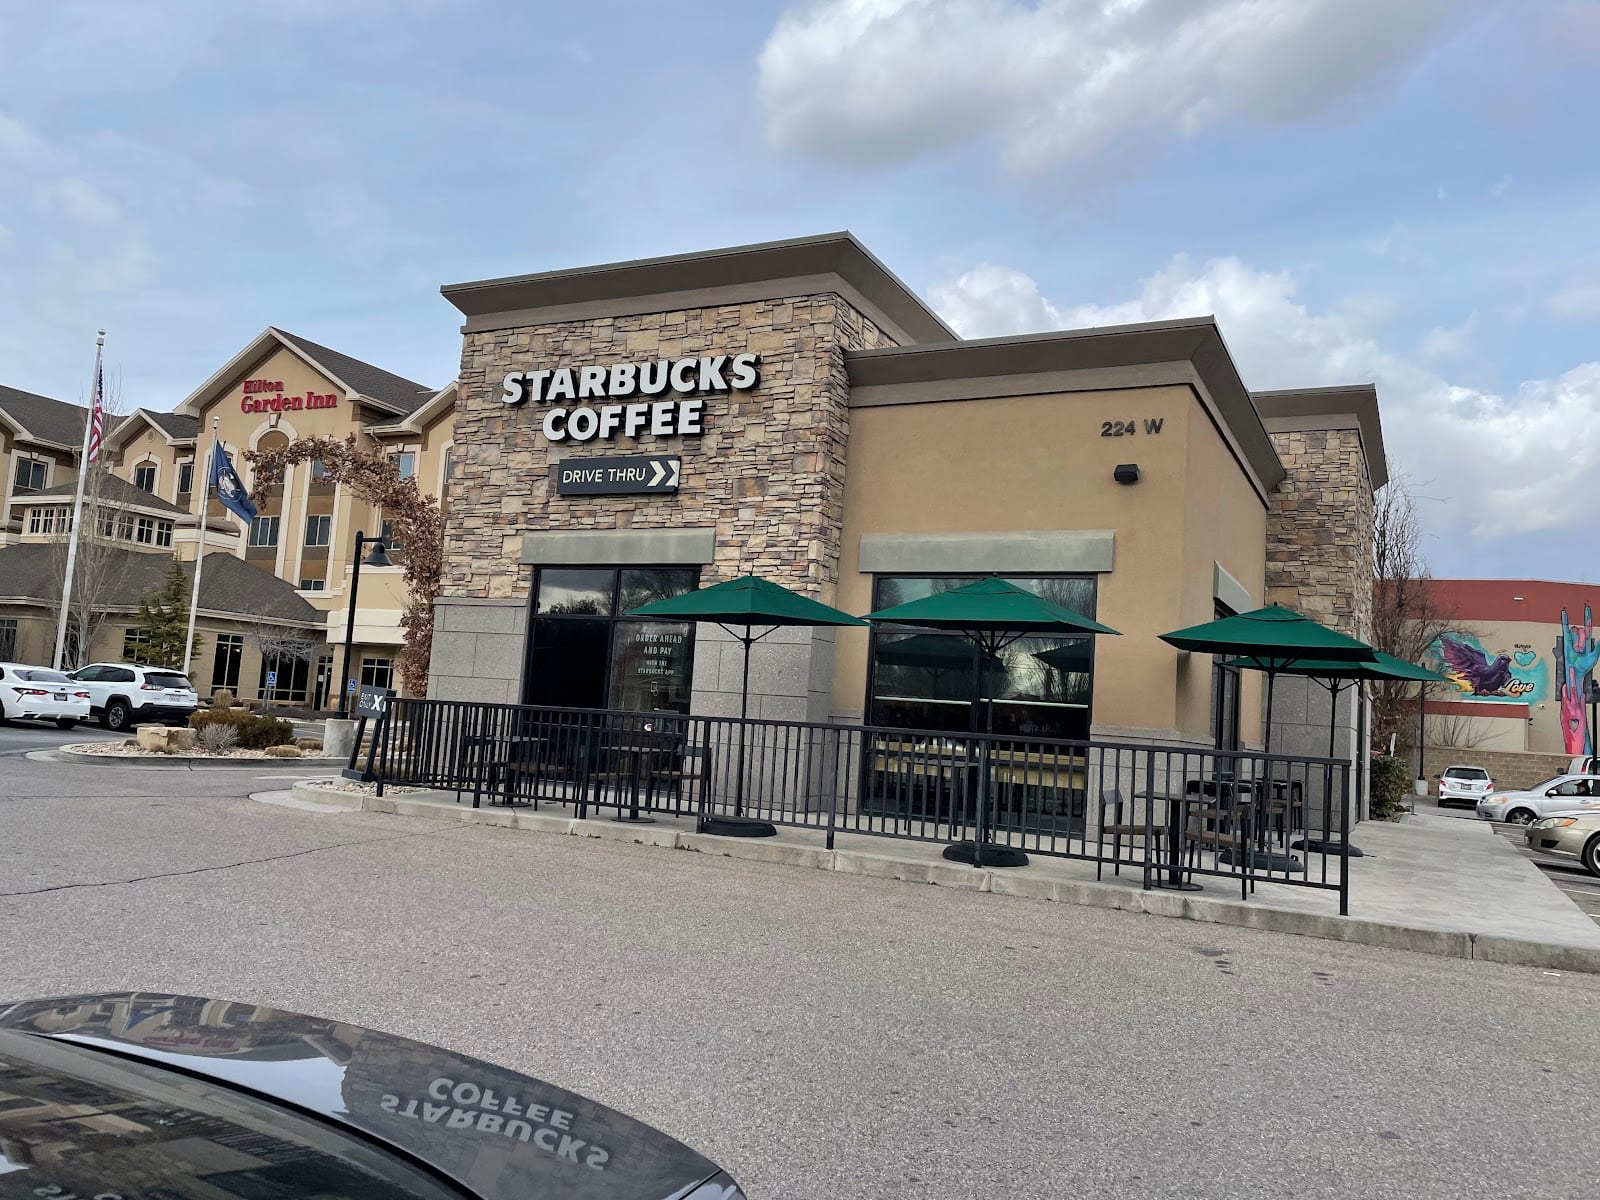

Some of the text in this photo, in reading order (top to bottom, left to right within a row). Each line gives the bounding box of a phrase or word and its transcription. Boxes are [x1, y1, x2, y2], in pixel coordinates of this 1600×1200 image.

[243, 380, 284, 393] Hilton
[502, 353, 758, 404] STARBUCKS
[241, 392, 337, 414] Garden Inn
[543, 400, 703, 441] COFFEE
[1101, 418, 1164, 437] 224 W
[562, 467, 646, 484] DRIVE THRU
[635, 633, 683, 644] ORDER AHEAD
[643, 646, 673, 656] AND PAY
[1503, 678, 1535, 698] Love
